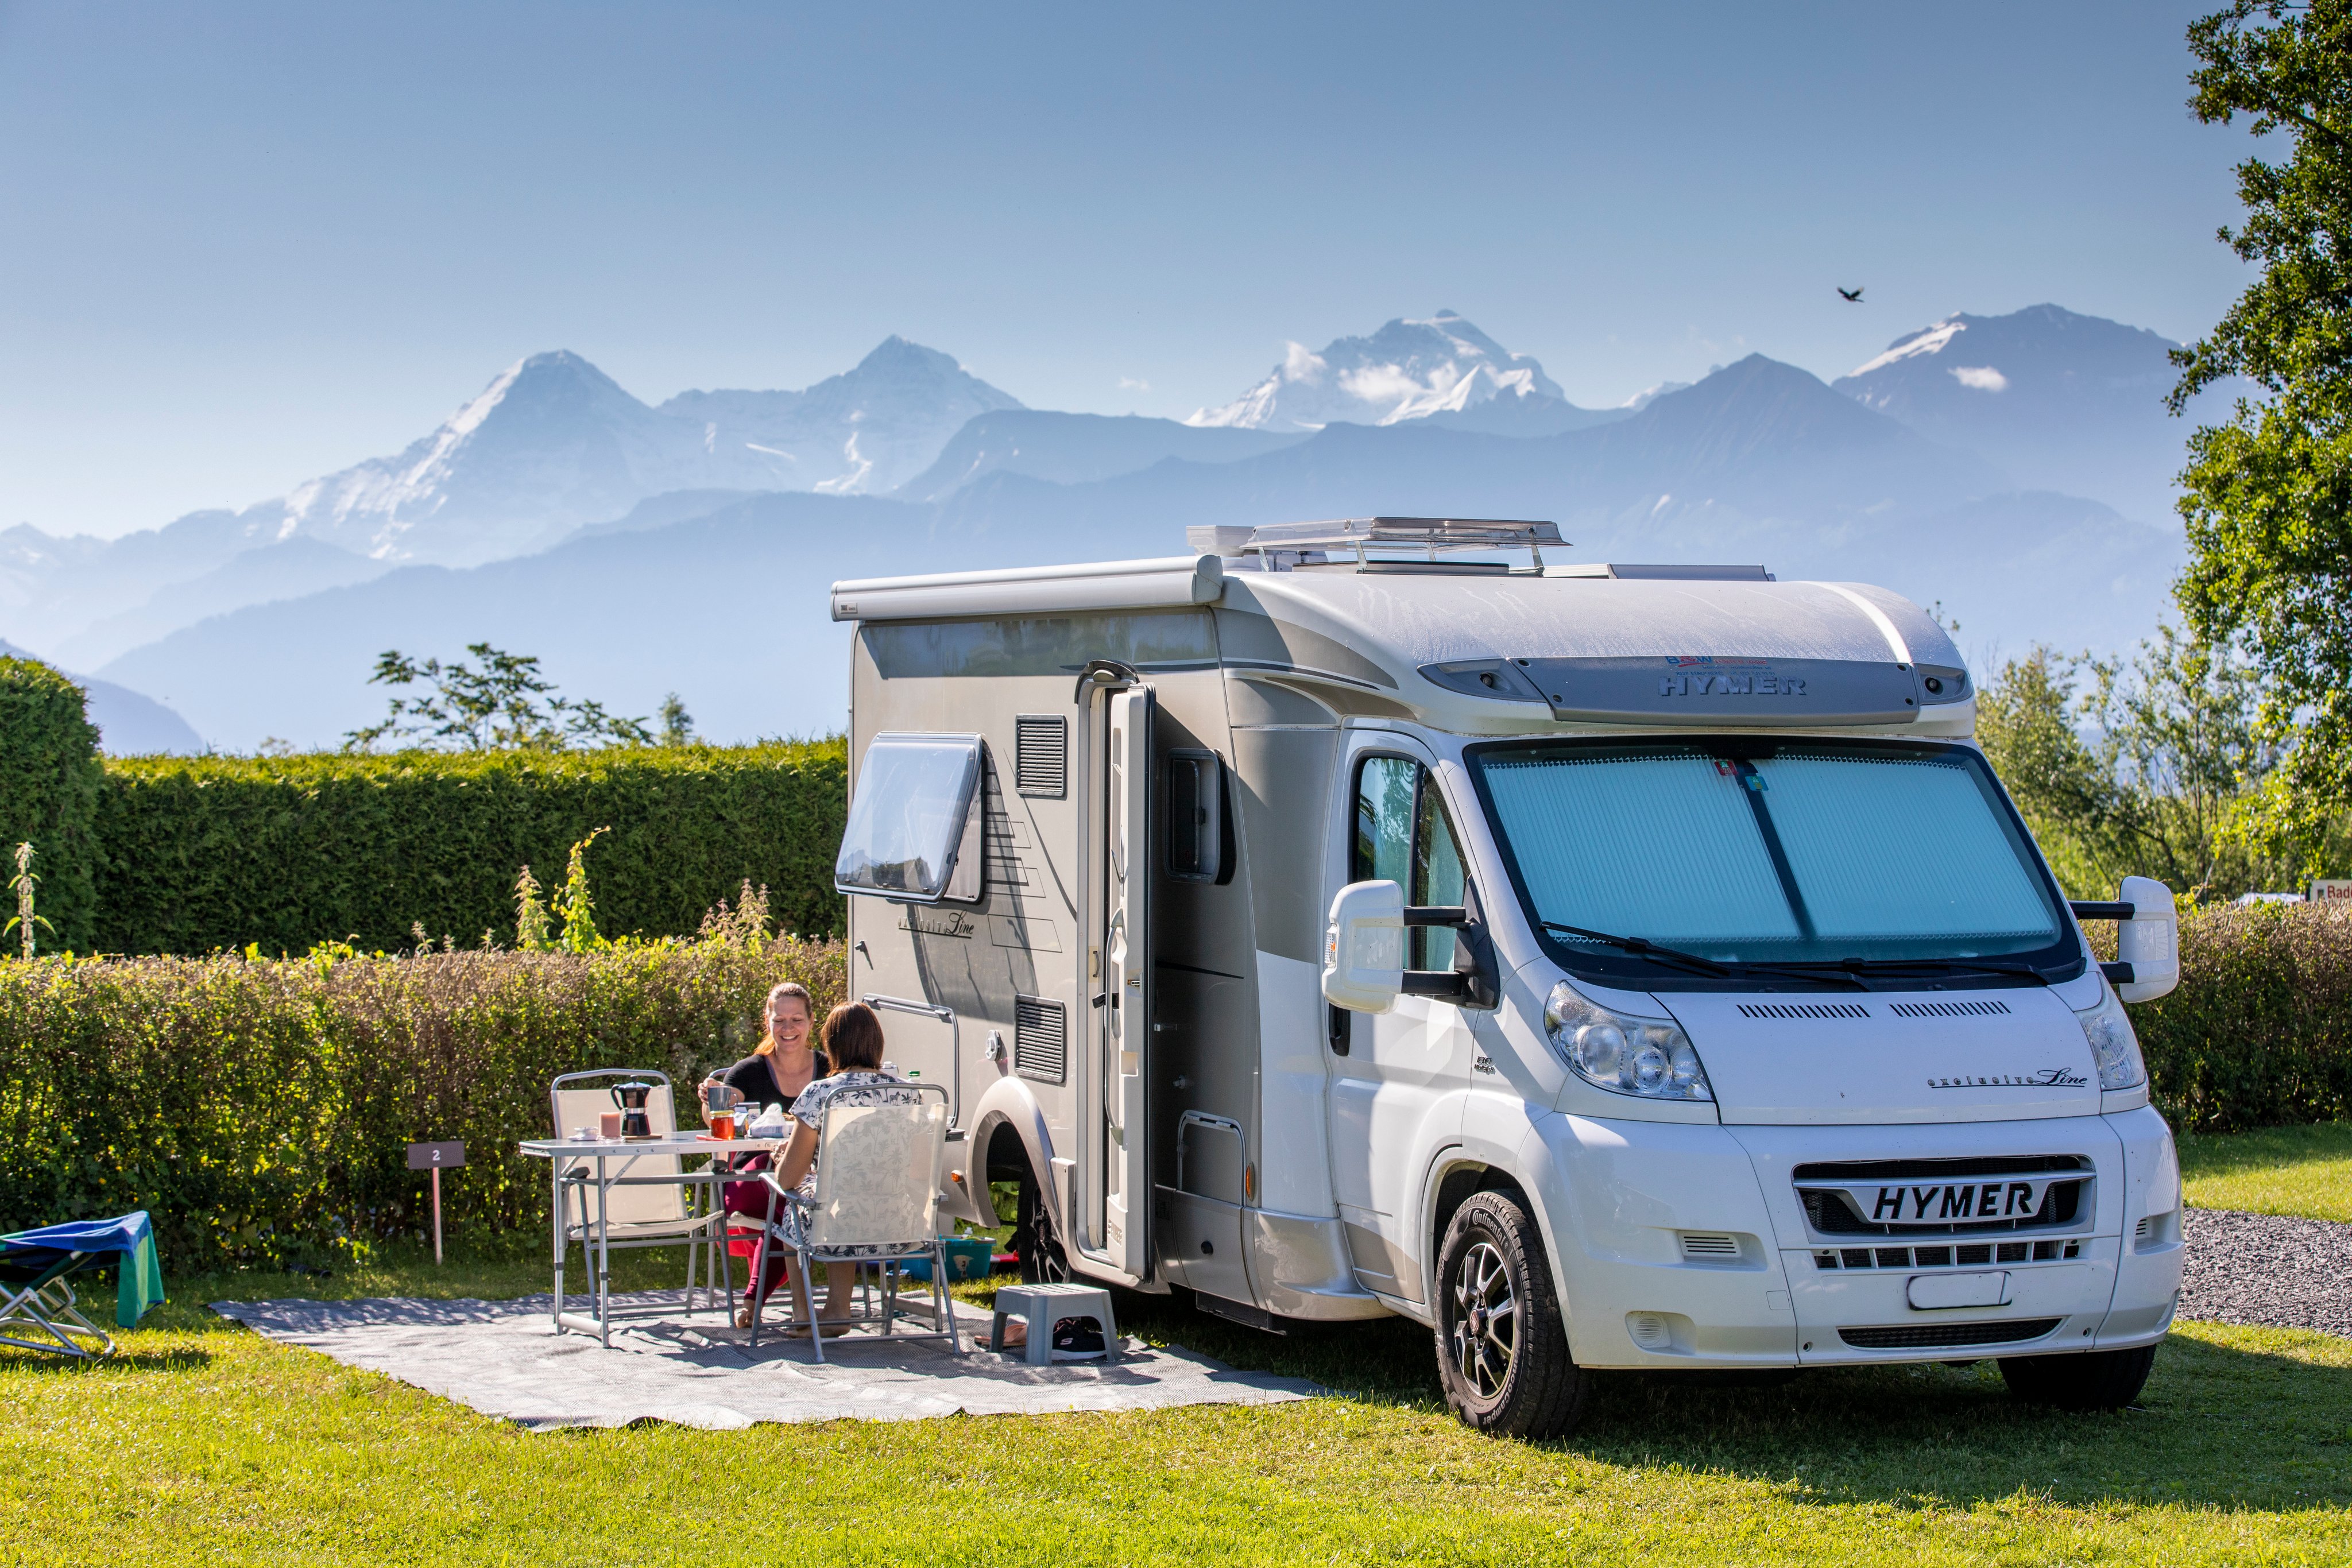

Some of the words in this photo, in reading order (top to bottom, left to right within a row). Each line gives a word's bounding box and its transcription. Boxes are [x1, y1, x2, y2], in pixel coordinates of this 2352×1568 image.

[1658, 676, 1806, 696] HYMER
[2327, 885, 2352, 899] Bad
[946, 909, 974, 935] Line
[1928, 1075, 2034, 1087] exclusive
[2033, 1067, 2088, 1085] Line
[432, 1149, 441, 1162] 2
[1873, 1182, 2034, 1219] HYMER
[1472, 1209, 1506, 1247] Continental
